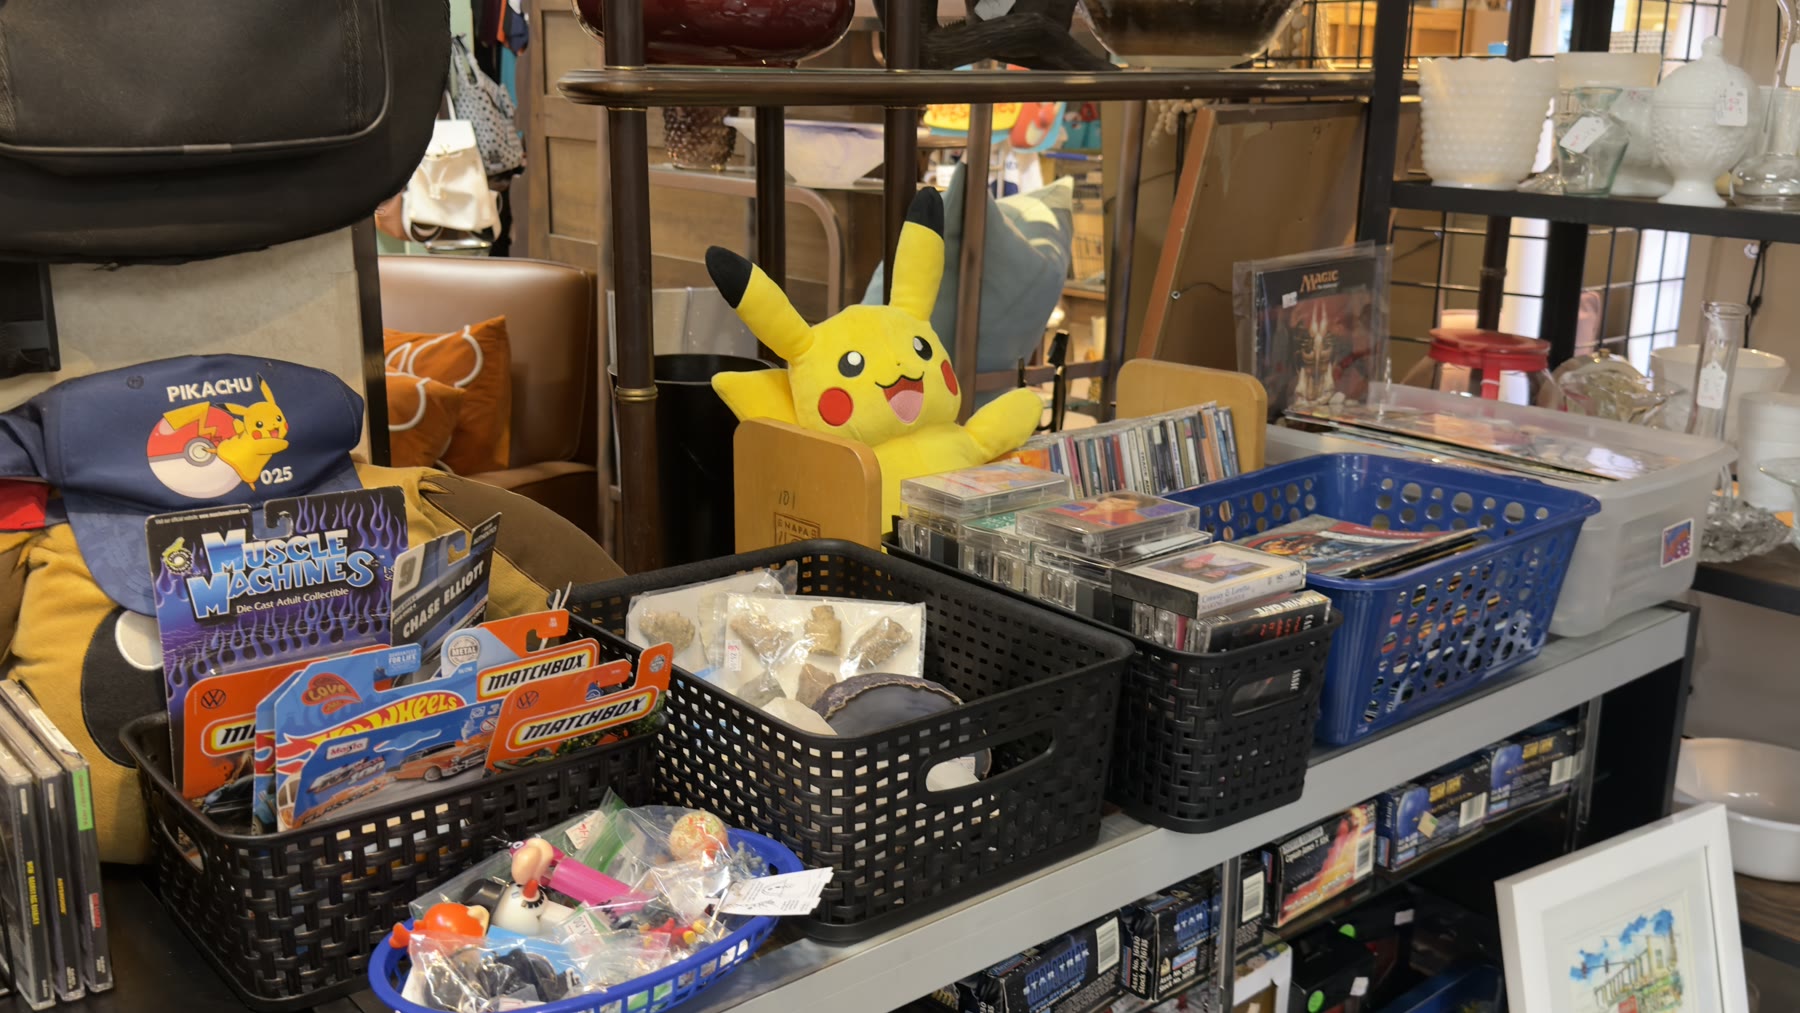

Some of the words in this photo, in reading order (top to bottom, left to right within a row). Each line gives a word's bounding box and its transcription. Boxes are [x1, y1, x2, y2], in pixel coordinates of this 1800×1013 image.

[166, 377, 253, 402] PIKACHU
[260, 466, 293, 485] 025
[201, 528, 348, 574] MUSCLE
[186, 550, 374, 619] MACHINES
[403, 598, 440, 638] CHASE
[444, 560, 484, 605] ELLIOTT
[236, 603, 252, 614] Die
[254, 600, 274, 611] Cast
[276, 596, 301, 607] Adult
[303, 588, 349, 602] Collectible
[389, 656, 402, 664] FOR
[402, 654, 416, 662] LIFE
[451, 646, 478, 657] METAL
[486, 653, 586, 692] MATCHBOX
[522, 697, 643, 742] MATCHBOX
[1174, 912, 1203, 932] STAR
[1023, 970, 1055, 995] STAR
[1058, 948, 1089, 972] TREK
